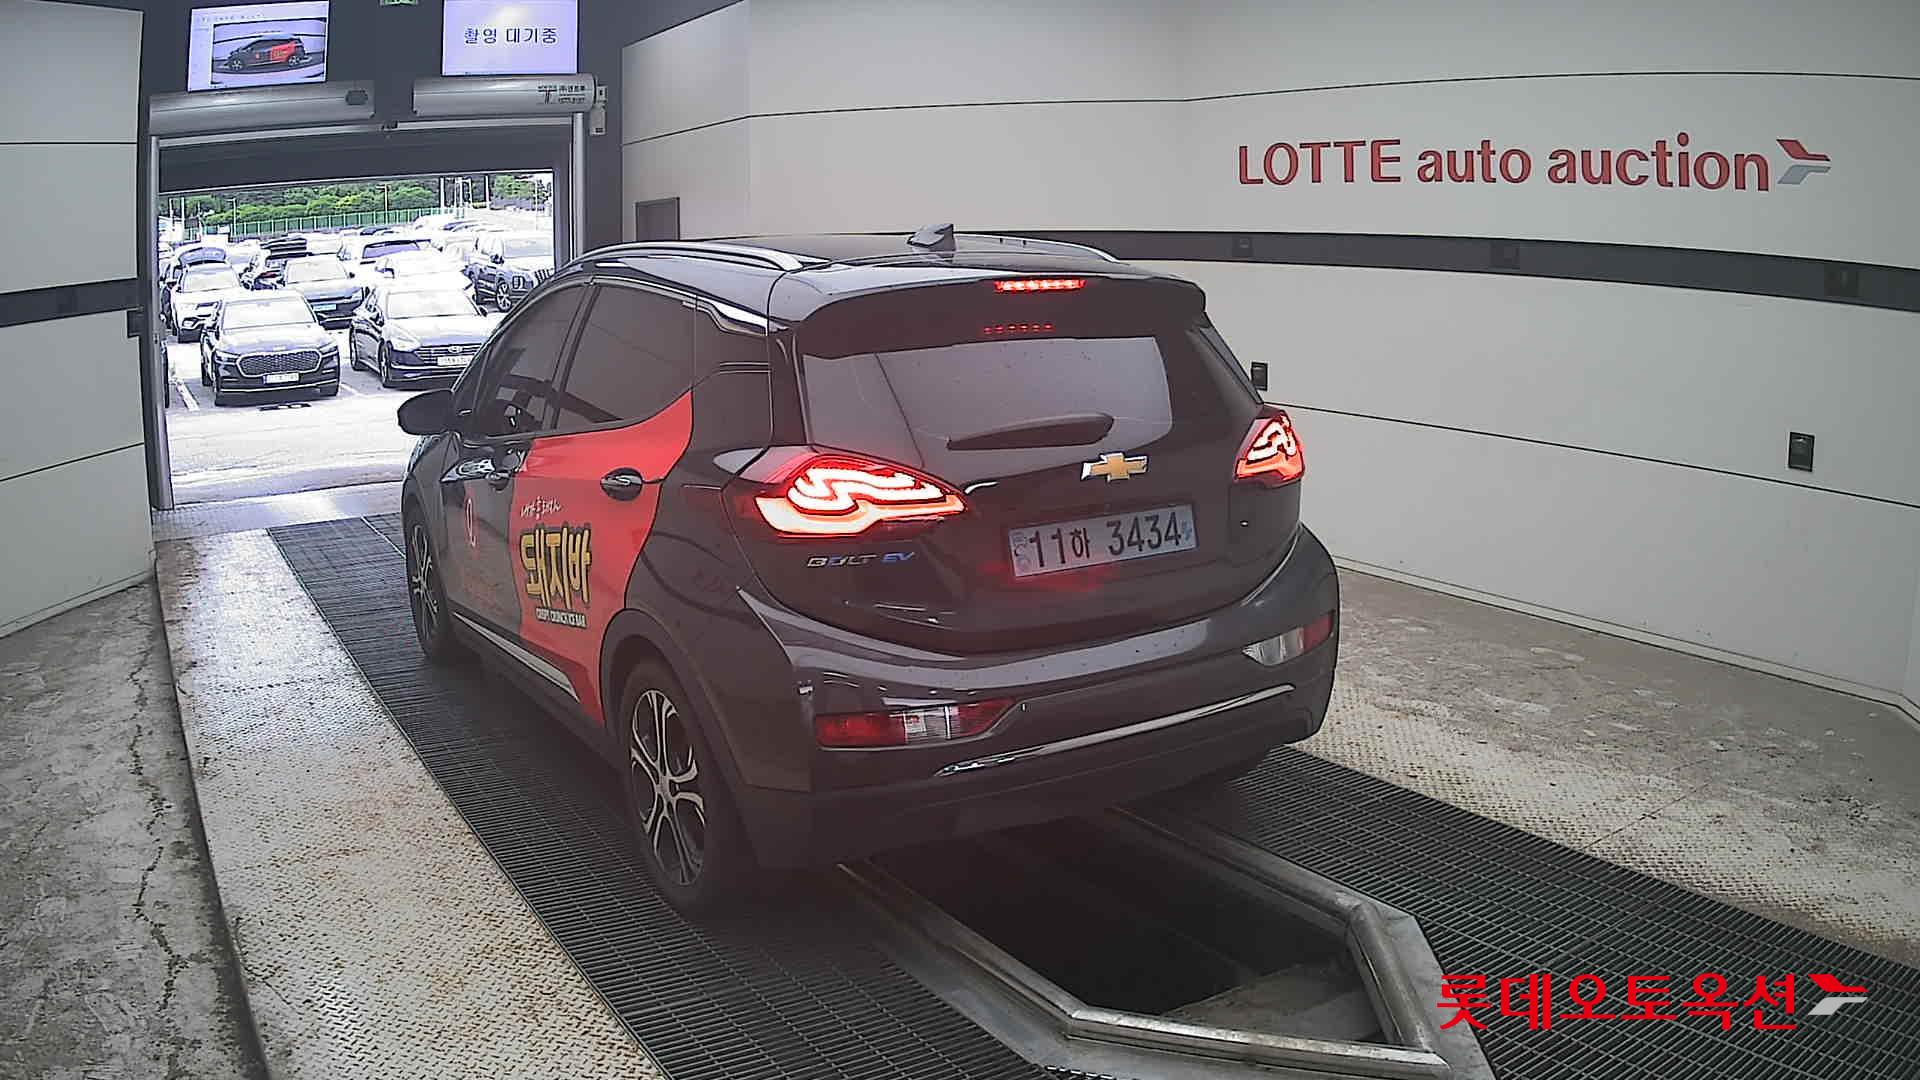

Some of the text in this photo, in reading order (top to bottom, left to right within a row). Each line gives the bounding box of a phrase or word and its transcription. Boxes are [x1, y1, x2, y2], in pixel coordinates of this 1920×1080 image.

[464, 27, 557, 44] 촬영 대기중
[1238, 131, 1769, 192] LOTTE auto auction
[1029, 511, 1182, 568] 11하 3434
[807, 551, 915, 567] BOLT EV
